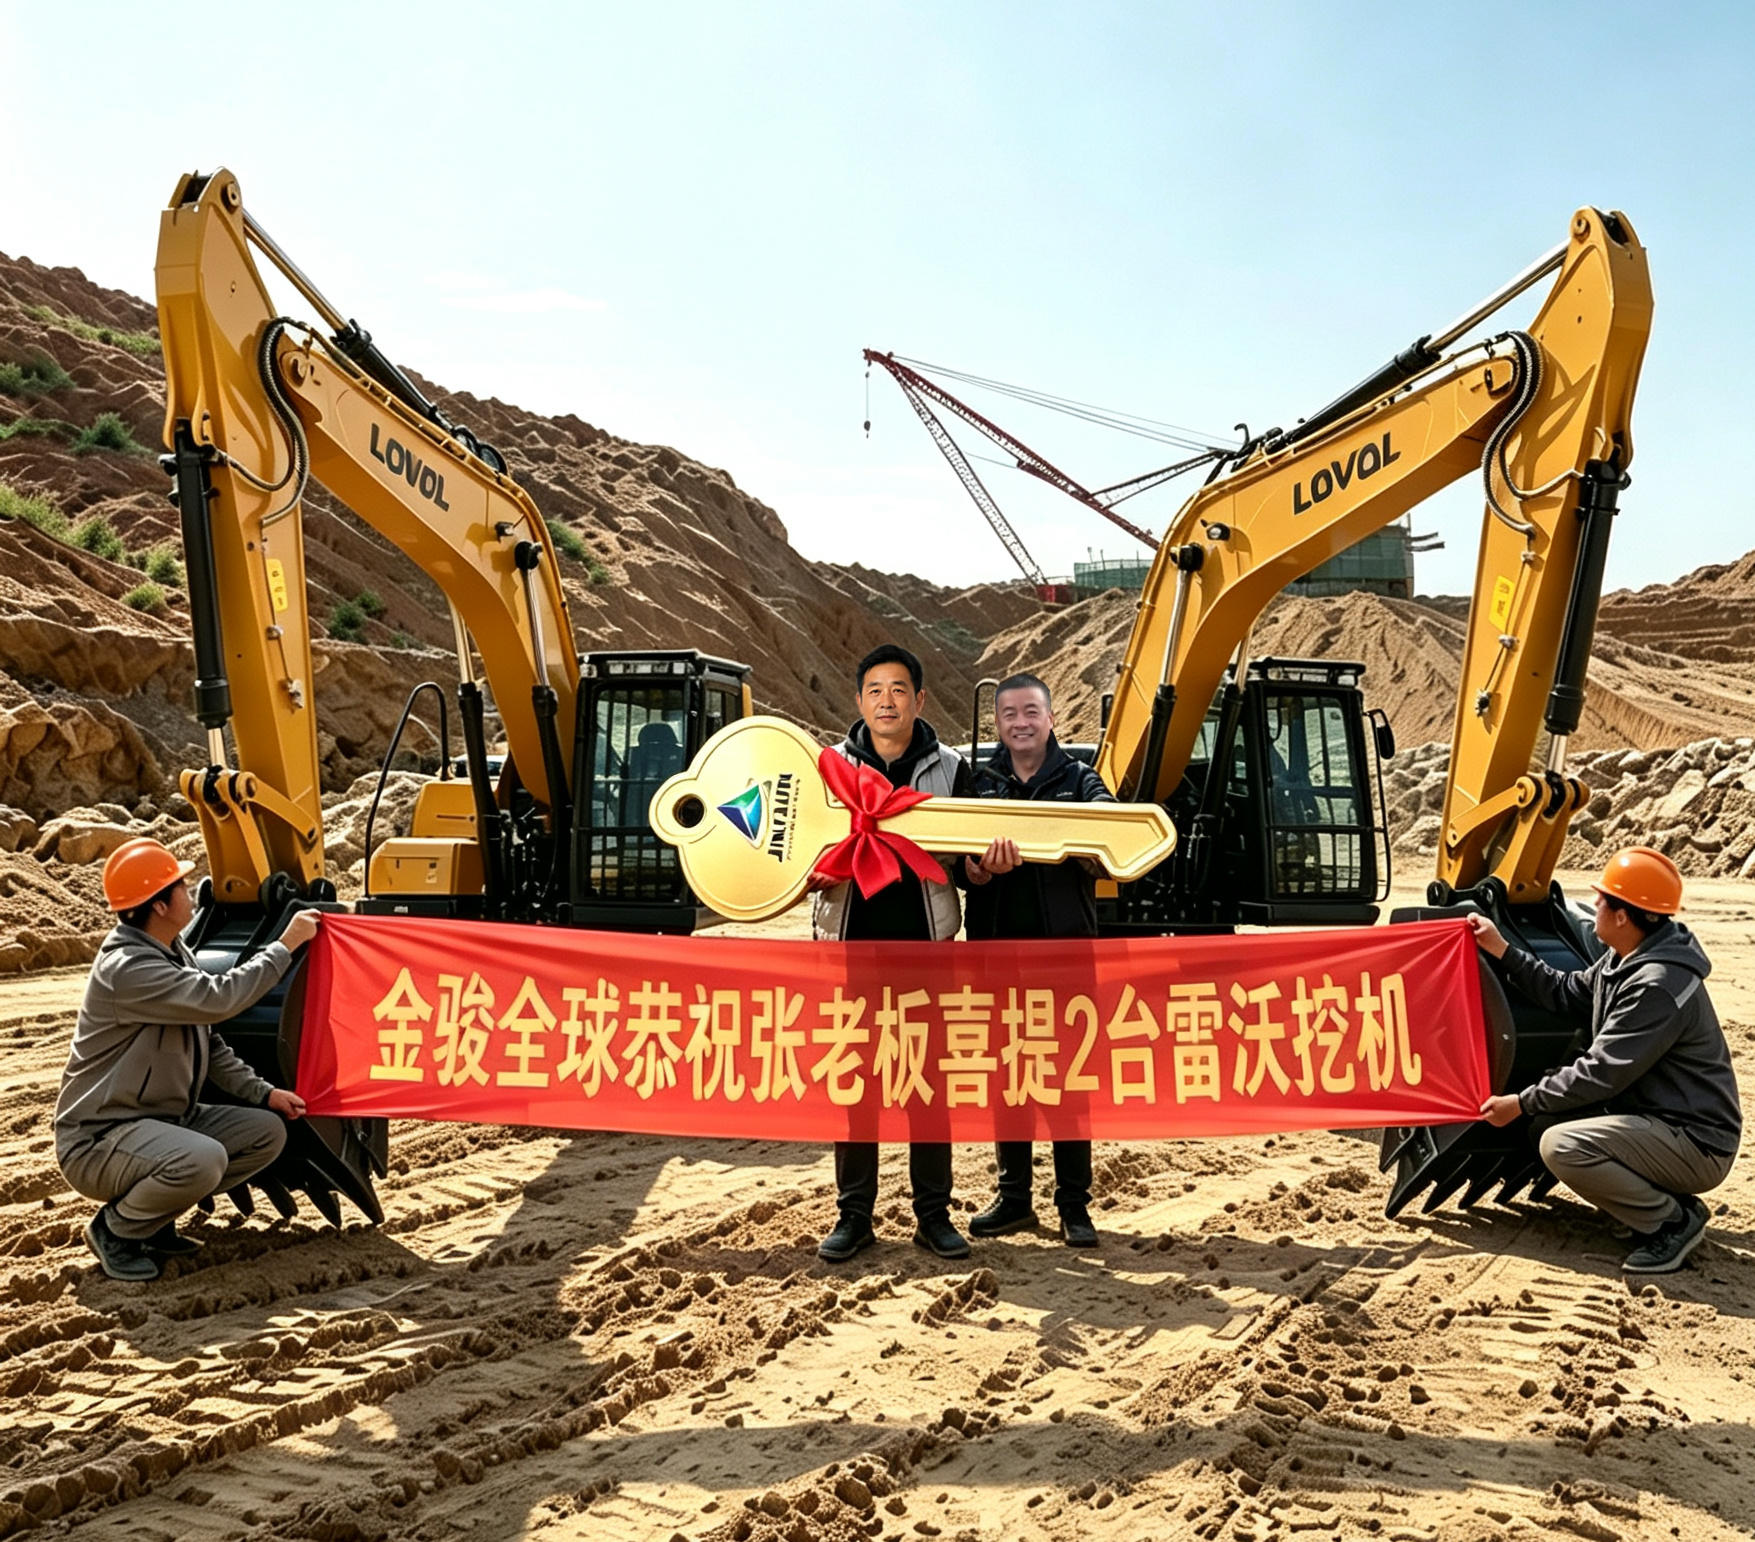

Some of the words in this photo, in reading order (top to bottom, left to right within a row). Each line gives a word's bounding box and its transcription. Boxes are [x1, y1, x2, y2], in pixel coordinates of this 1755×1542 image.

[370, 423, 449, 512] LOVOL
[1294, 432, 1401, 515] LOVOL
[369, 967, 1422, 1108] 金骏全球恭祝张老板喜提2台雷沃挖机
